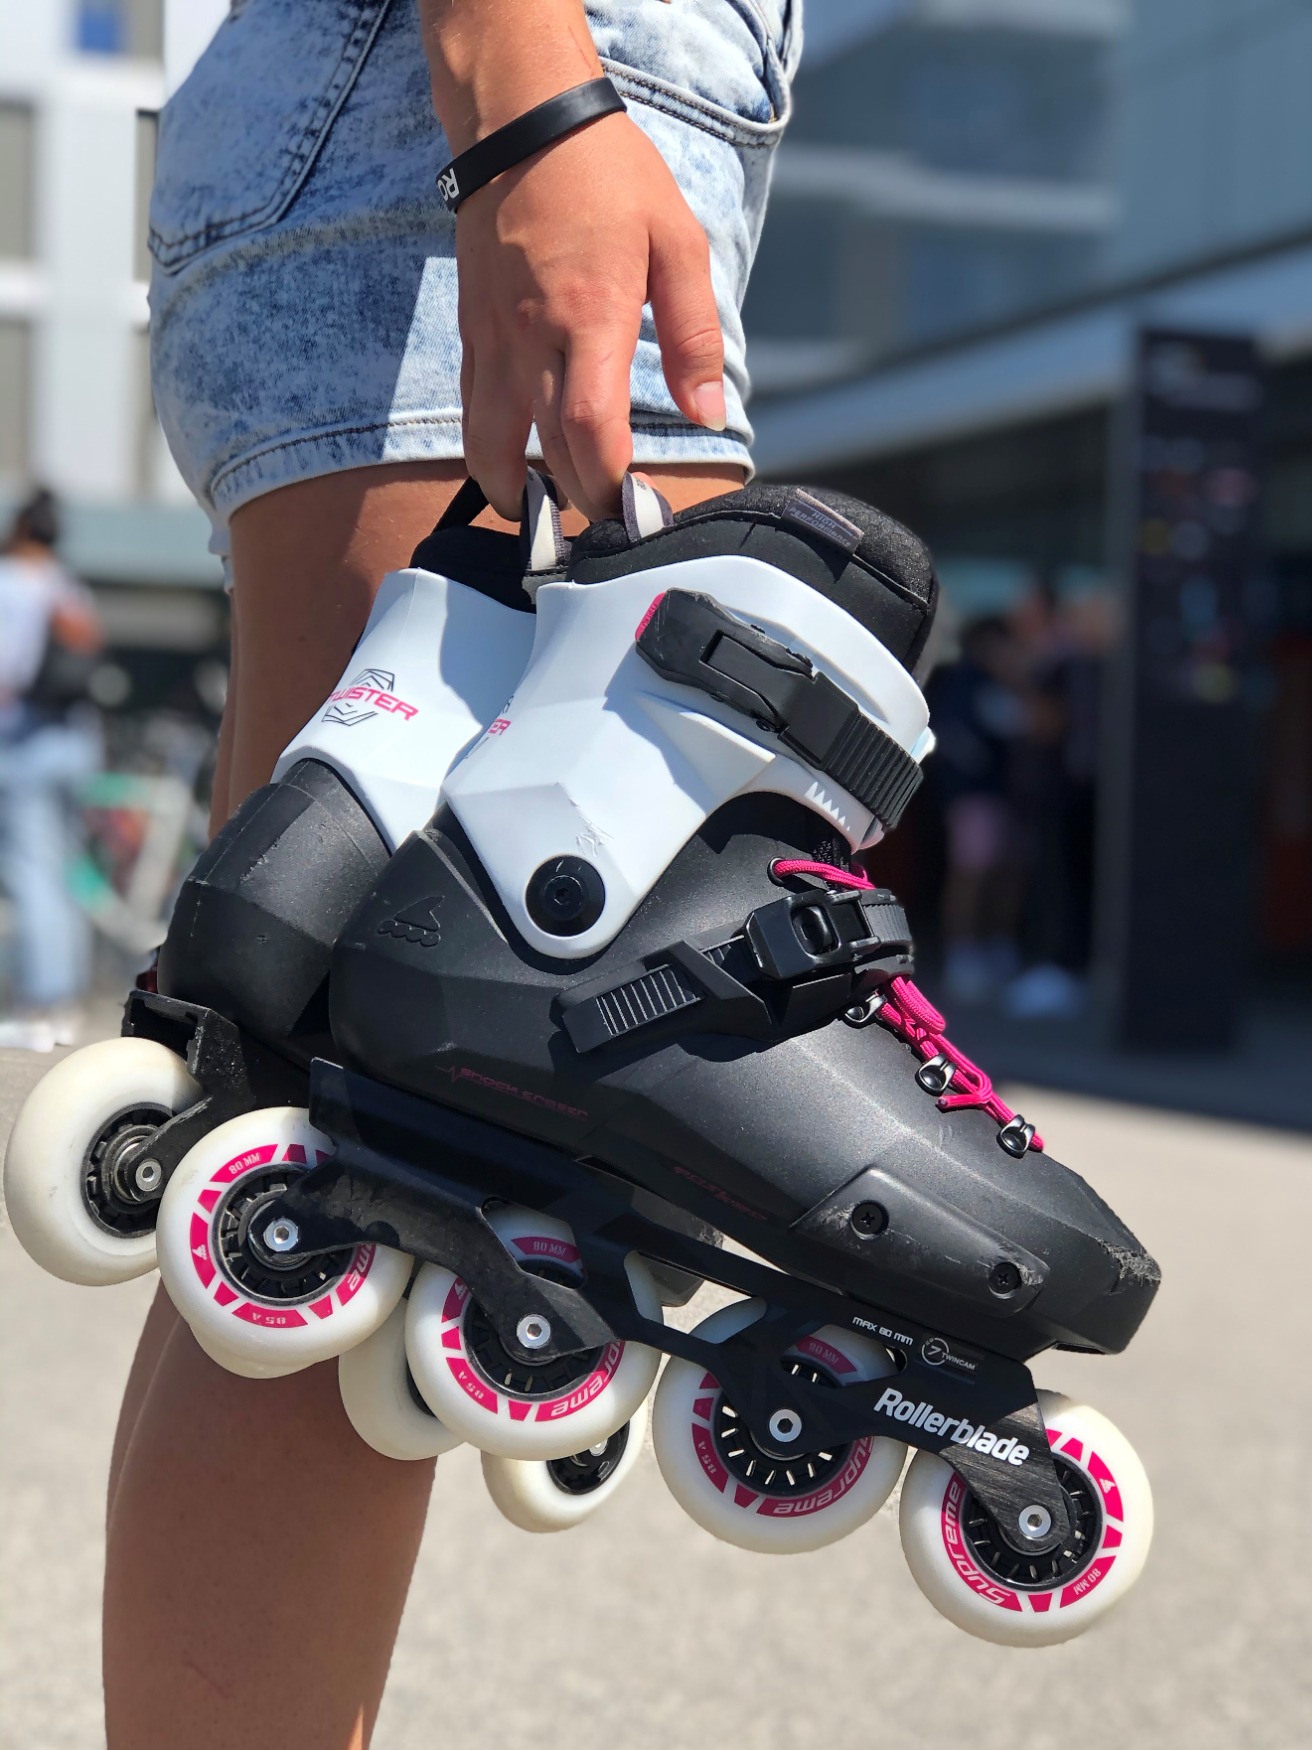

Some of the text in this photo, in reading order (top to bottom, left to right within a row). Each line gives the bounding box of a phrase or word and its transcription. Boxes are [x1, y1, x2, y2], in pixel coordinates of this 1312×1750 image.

[228, 1152, 261, 1175] 80 MM
[532, 1240, 548, 1252] 80
[940, 1350, 977, 1371] TWINCAM
[873, 1387, 1031, 1467] Rollerblade
[944, 1481, 1012, 1605] Supreme
[1088, 1567, 1102, 1584] 80
